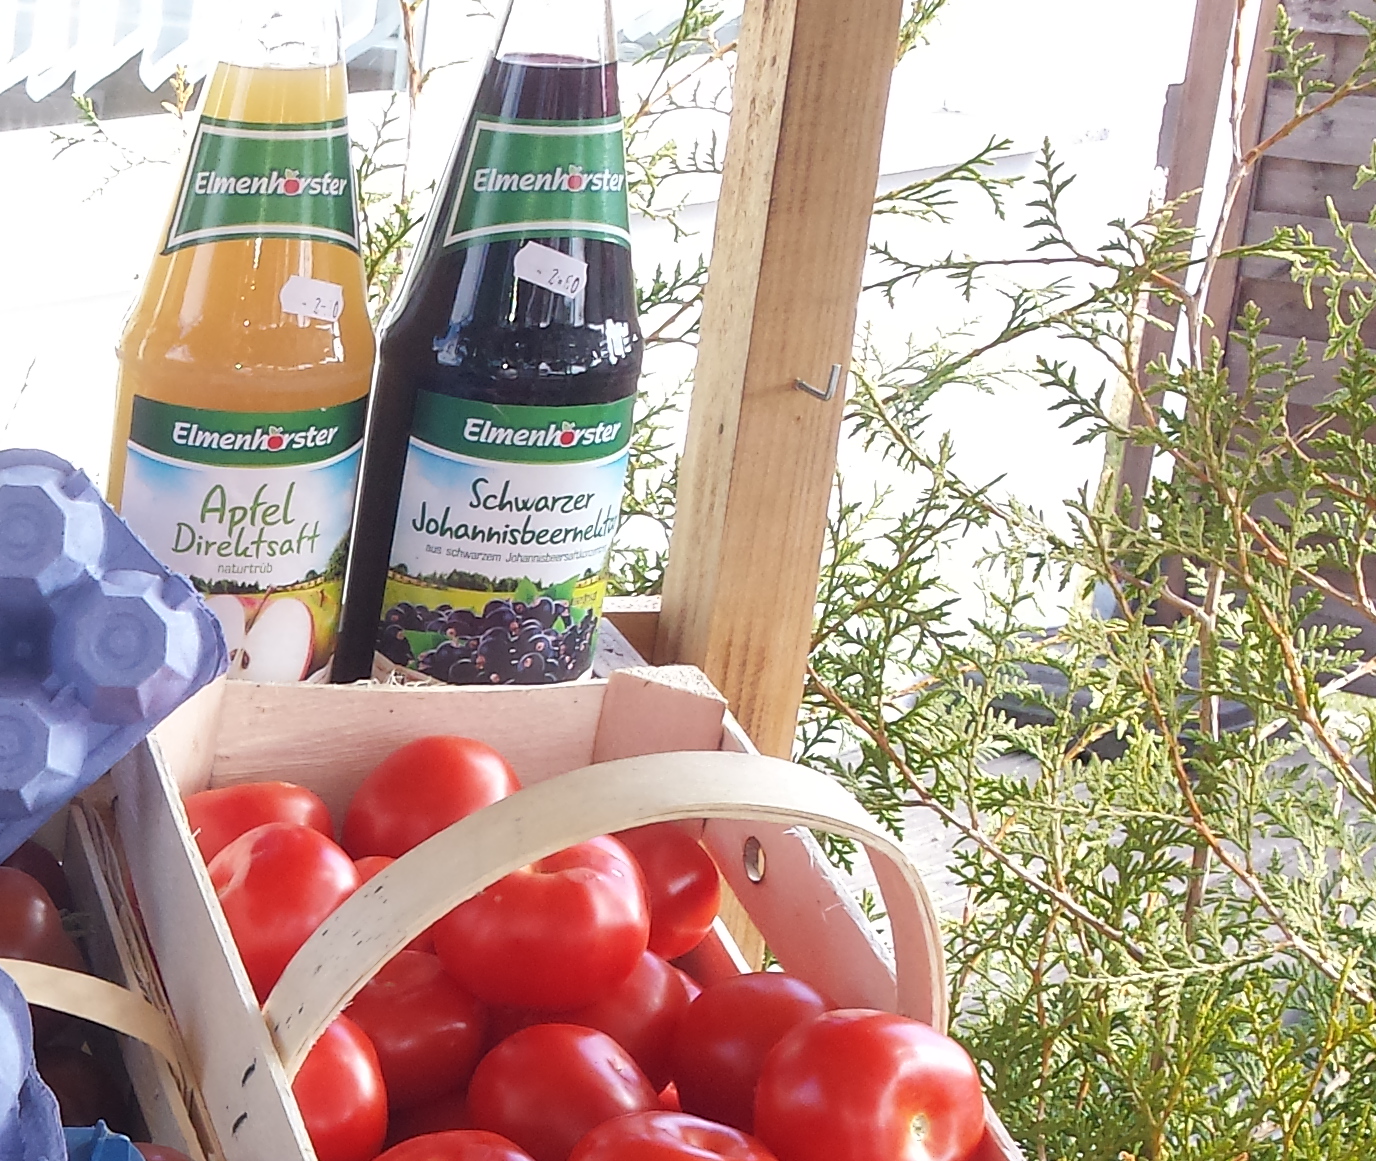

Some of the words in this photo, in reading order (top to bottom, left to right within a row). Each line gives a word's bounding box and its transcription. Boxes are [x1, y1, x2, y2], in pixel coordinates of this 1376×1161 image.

[194, 168, 347, 196] Elmenhorster
[473, 165, 624, 192] Elmenhorster
[172, 421, 338, 451] Elmenhorster
[463, 418, 622, 447] Elmenhorster
[200, 481, 295, 538] Apfel
[469, 477, 595, 514] Schwarzer
[171, 521, 321, 559] Direktsaft
[217, 563, 273, 574] naturtrüb
